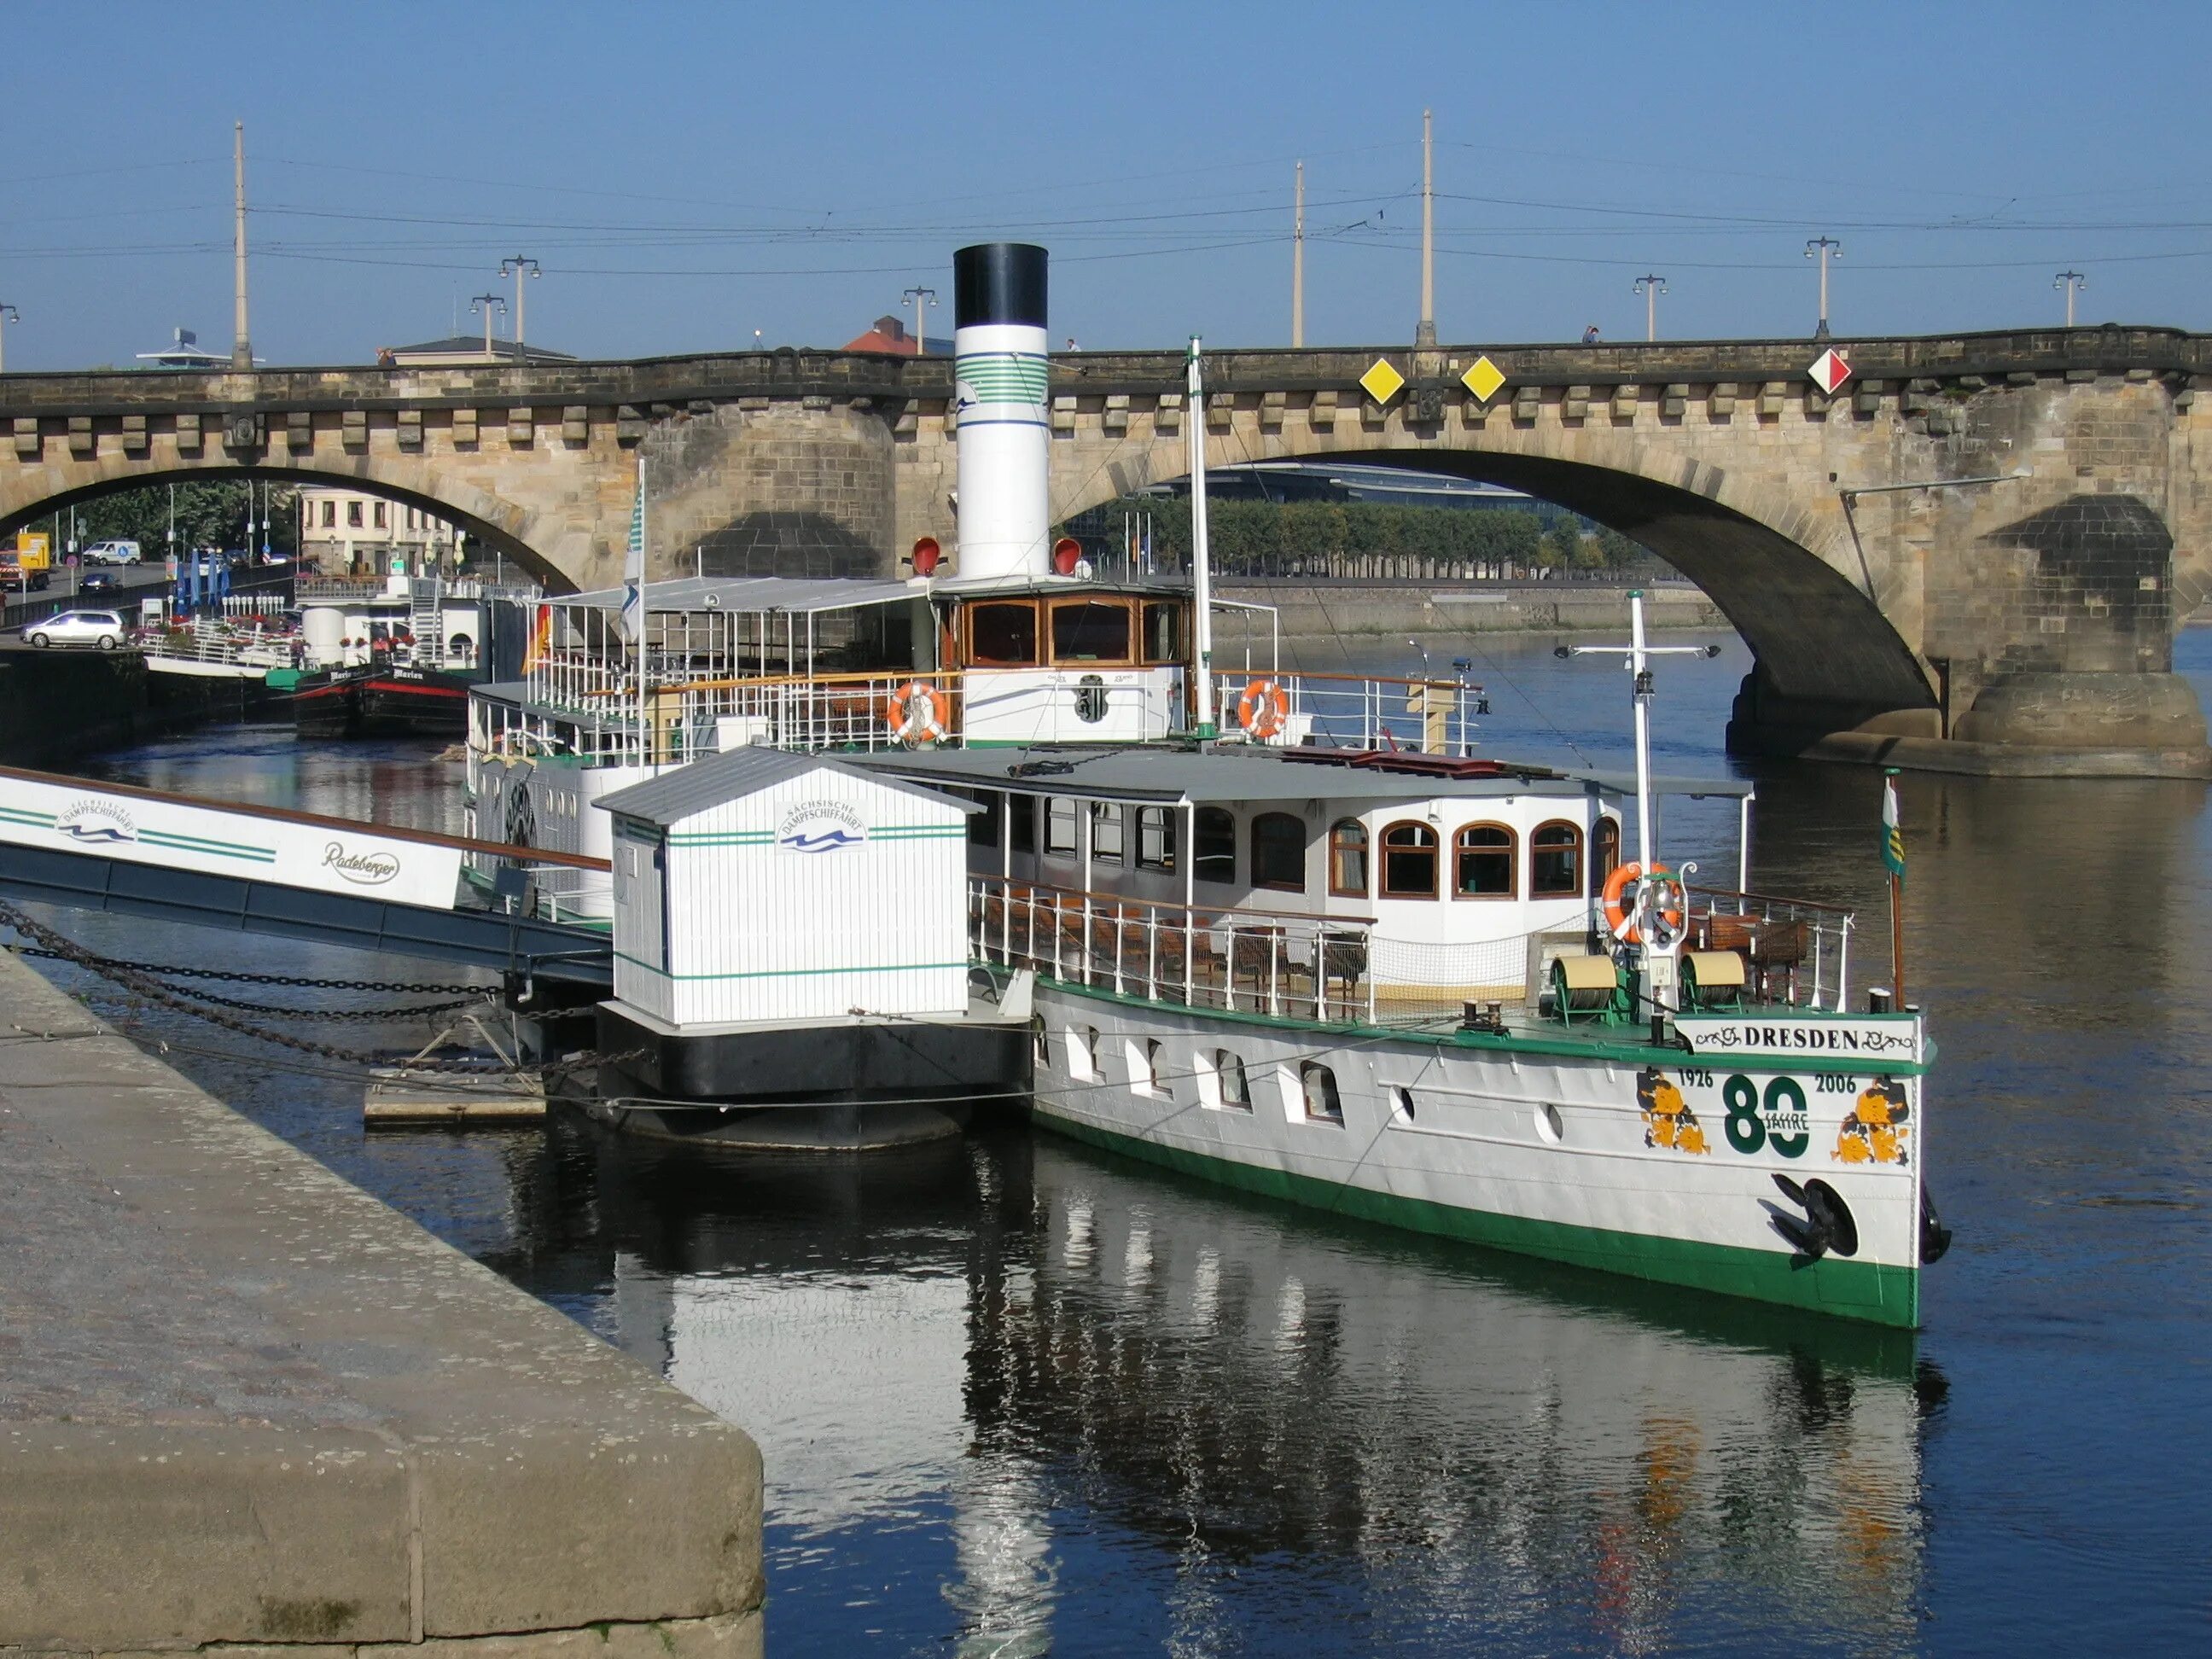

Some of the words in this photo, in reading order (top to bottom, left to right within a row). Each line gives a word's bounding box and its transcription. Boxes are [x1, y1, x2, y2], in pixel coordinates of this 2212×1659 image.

[63, 806, 135, 832] DAMPFSCHIFFAHRT
[786, 800, 856, 818] SÄCHSISCHE
[782, 808, 862, 835] DAMPFSCHIFFAHRT
[321, 841, 398, 879] Radeberger
[1744, 1027, 1859, 1050] DRESDEN
[1678, 1068, 1714, 1088] 1926
[1814, 1073, 1856, 1093] 2006
[1722, 1074, 1809, 1158] 80
[1765, 1113, 1809, 1131] JAHRE
